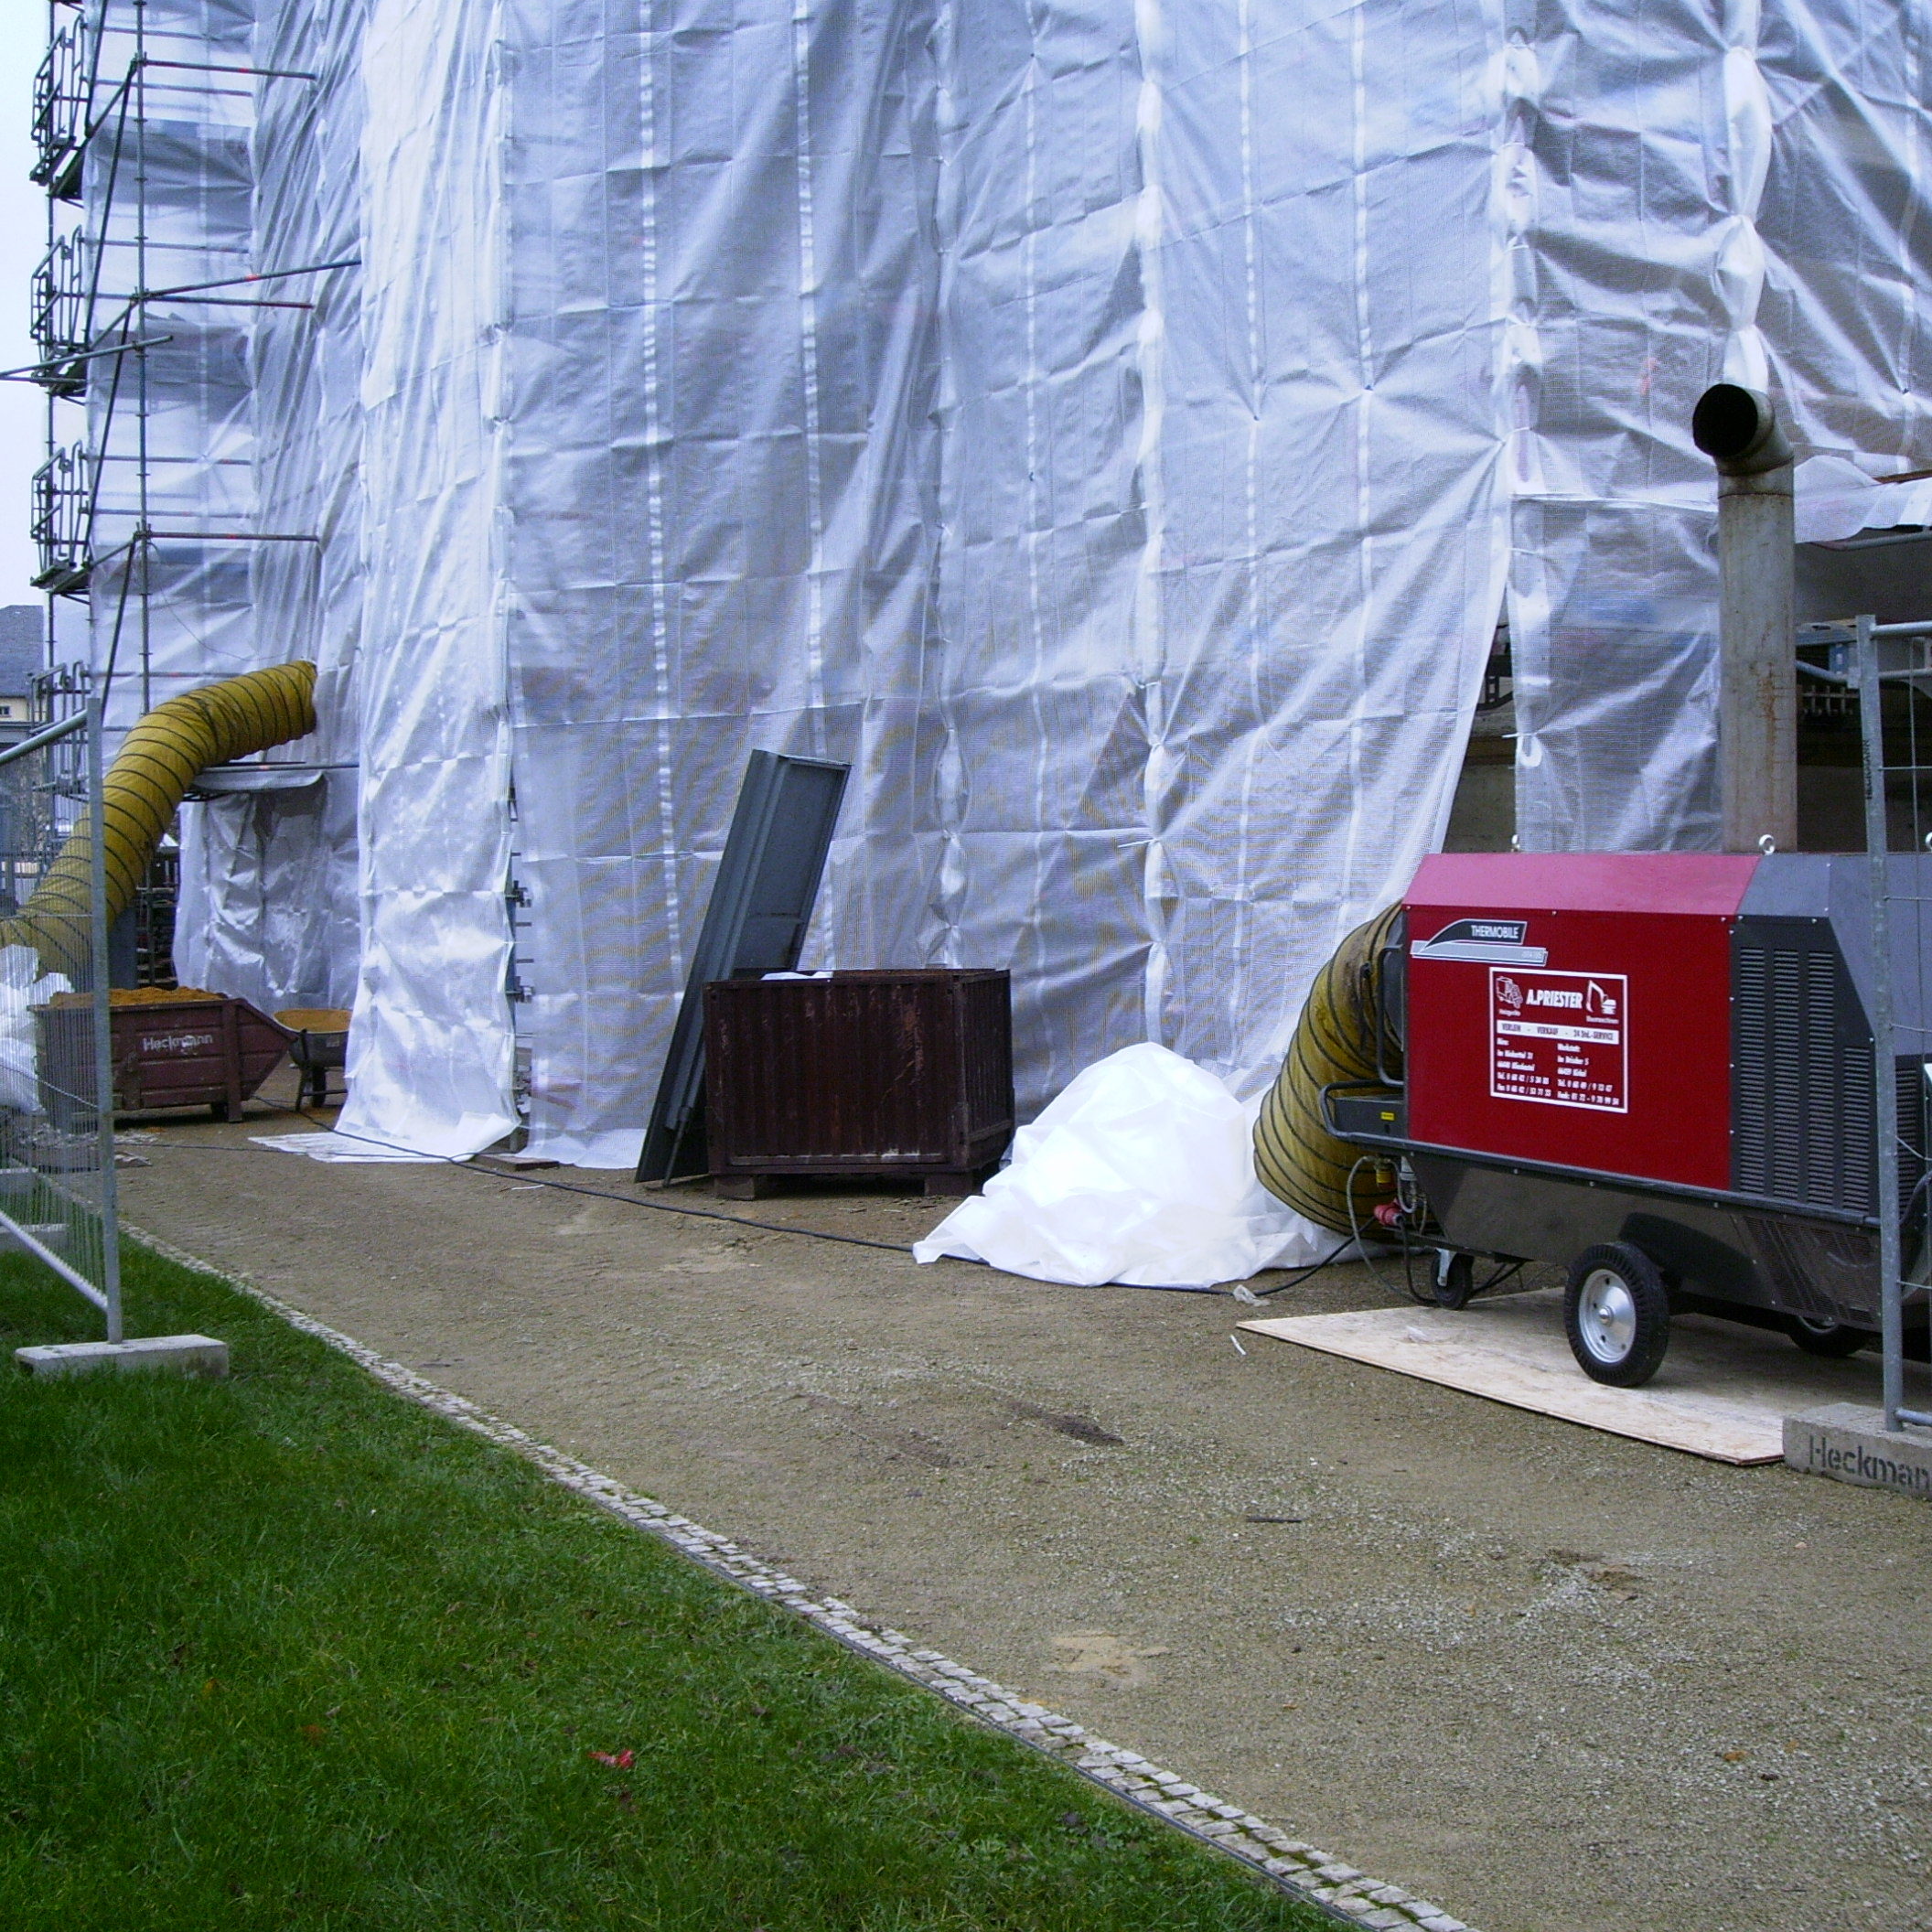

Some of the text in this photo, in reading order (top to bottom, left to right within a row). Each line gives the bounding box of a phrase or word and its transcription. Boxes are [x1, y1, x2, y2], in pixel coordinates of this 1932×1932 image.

[1471, 925, 1520, 939] THERMOBILE
[1526, 989, 1583, 1009] A.PRIESTER
[1537, 1026, 1558, 1035] VERKAUF
